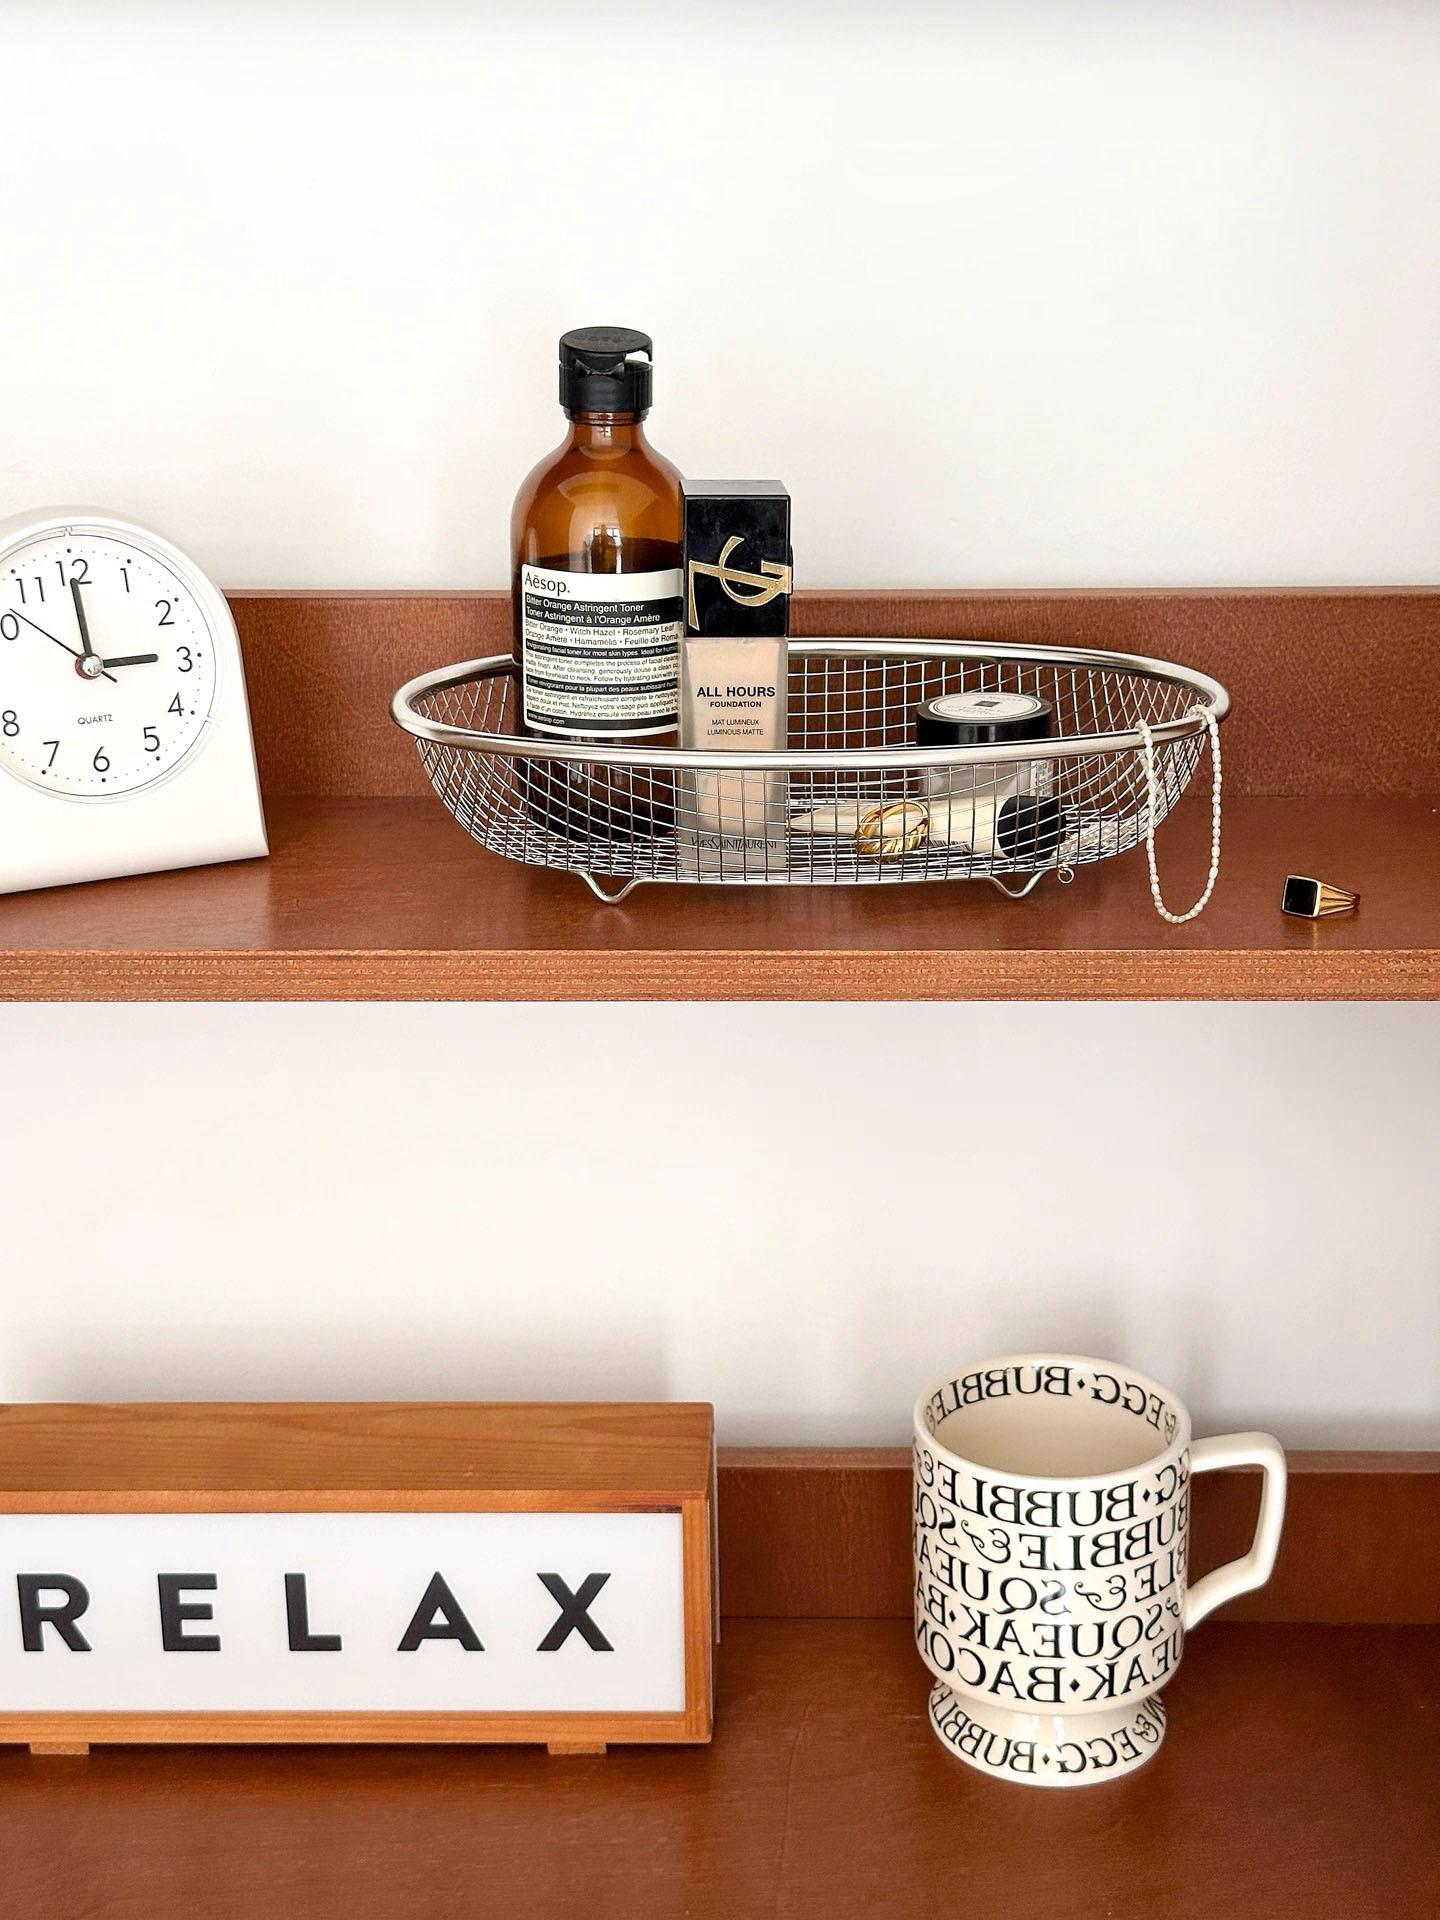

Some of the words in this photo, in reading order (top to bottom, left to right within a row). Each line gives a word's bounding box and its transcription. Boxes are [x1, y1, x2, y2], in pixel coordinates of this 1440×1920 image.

[56, 559, 92, 587] 12
[120, 568, 130, 593] 1
[16, 576, 45, 604] 11
[155, 600, 175, 626] 2
[543, 599, 572, 612] Orange
[573, 602, 618, 614] Astringent
[620, 604, 645, 612] Toner
[526, 606, 544, 618] Toner
[544, 611, 584, 624] Astringent
[586, 615, 592, 624] à
[594, 615, 632, 626] l'Orange
[633, 614, 660, 623] Amère
[540, 622, 563, 634] Orange
[570, 627, 591, 636] Witch
[593, 628, 615, 636] Hazel
[622, 626, 660, 636] Rosemary
[546, 634, 568, 644] Amère
[624, 638, 649, 646] Feuille
[650, 636, 660, 644] de
[176, 646, 193, 672] 3
[574, 660, 604, 668] completes
[545, 670, 569, 680] forehead
[623, 674, 650, 682] hydrating
[552, 664, 566, 672] After
[564, 684, 579, 692] pour
[696, 686, 722, 697] ALL
[726, 686, 775, 698] HOURS
[168, 692, 185, 716] 4
[572, 702, 598, 710] Nettoyez
[78, 714, 113, 725] QUARTZ
[570, 709, 596, 717] Hydratez
[1, 710, 20, 737] 8
[707, 728, 741, 736] LUMINOUS
[742, 728, 764, 736] MATTE
[143, 726, 161, 752] 5
[43, 740, 60, 767] 7
[93, 746, 110, 772] 6
[17, 1571, 614, 1652] RELAX
